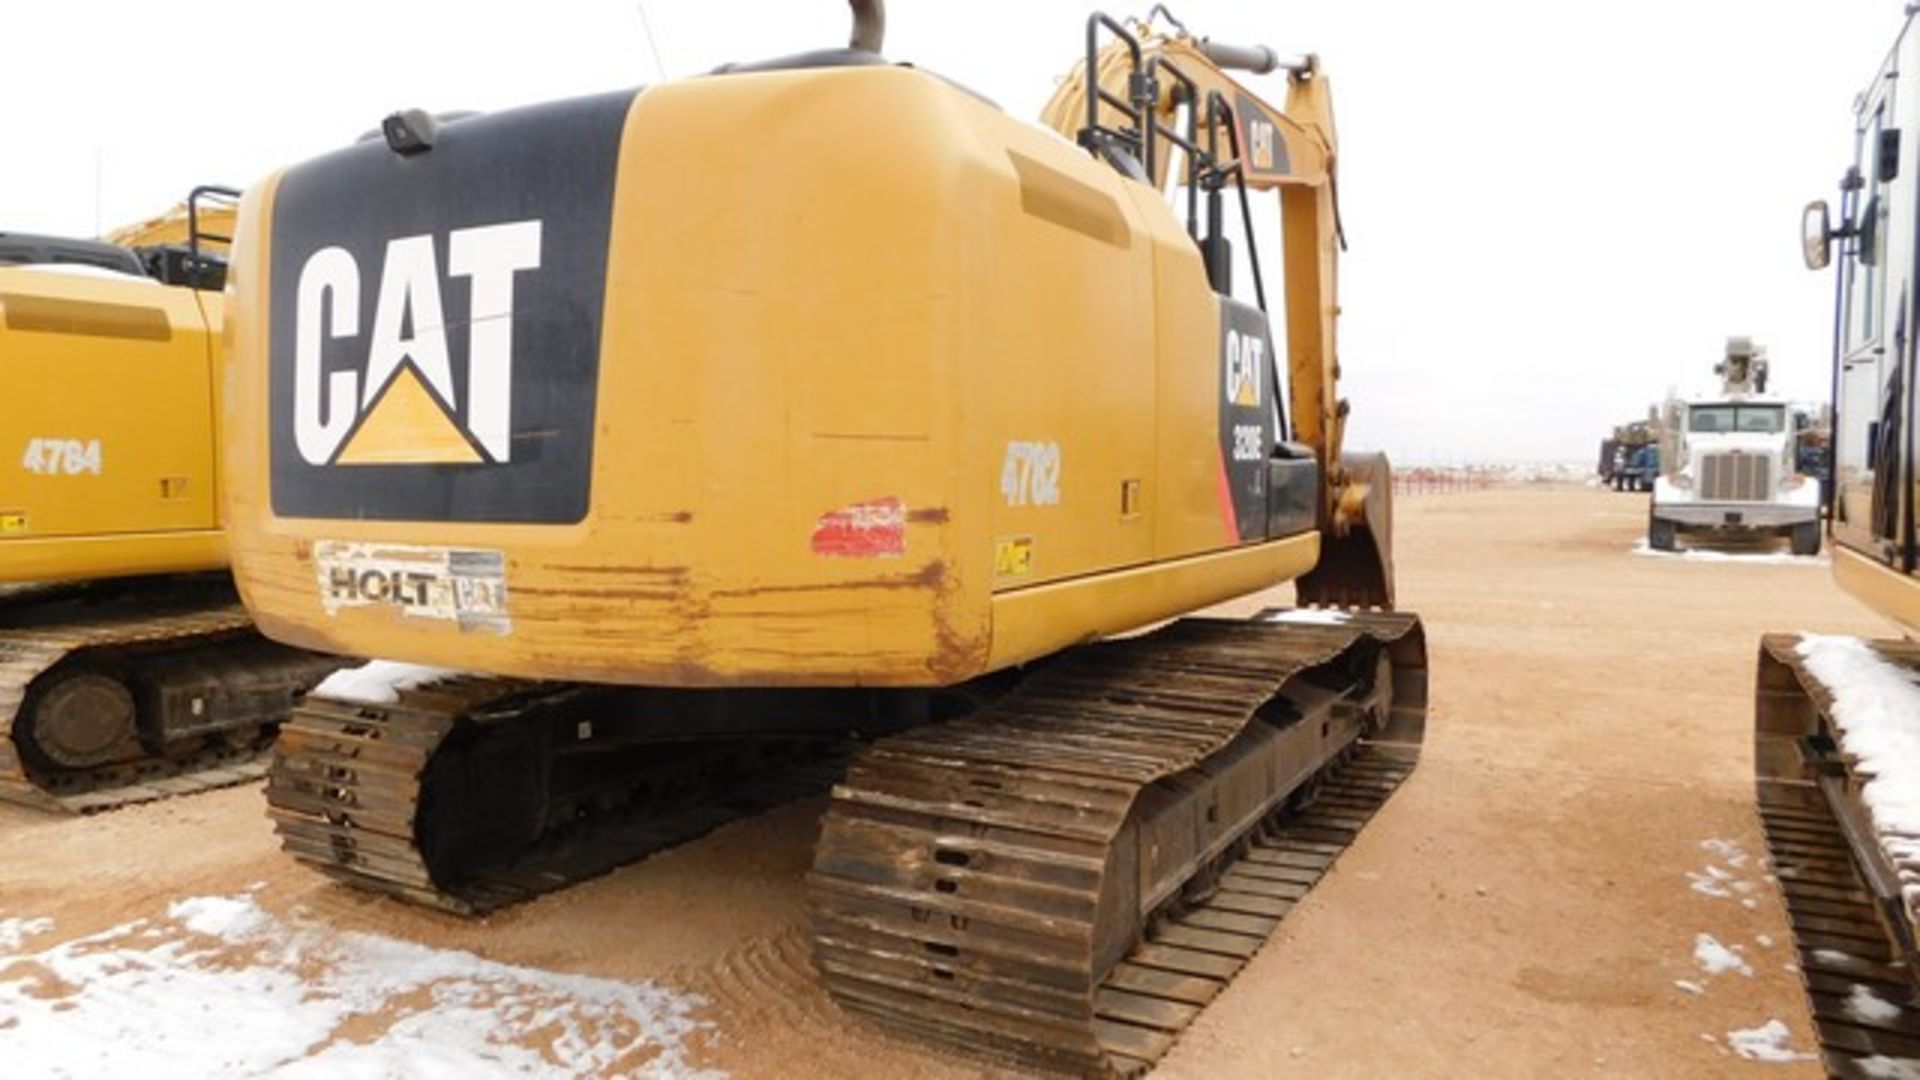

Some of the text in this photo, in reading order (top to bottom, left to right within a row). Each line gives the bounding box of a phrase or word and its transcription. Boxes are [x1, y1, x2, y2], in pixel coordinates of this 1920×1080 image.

[1251, 120, 1272, 168] CAT
[294, 219, 543, 466] CAT
[1226, 329, 1263, 406] CAT
[23, 437, 103, 475] 4784
[1001, 440, 1060, 507] 4782
[330, 567, 436, 606] HOLT
